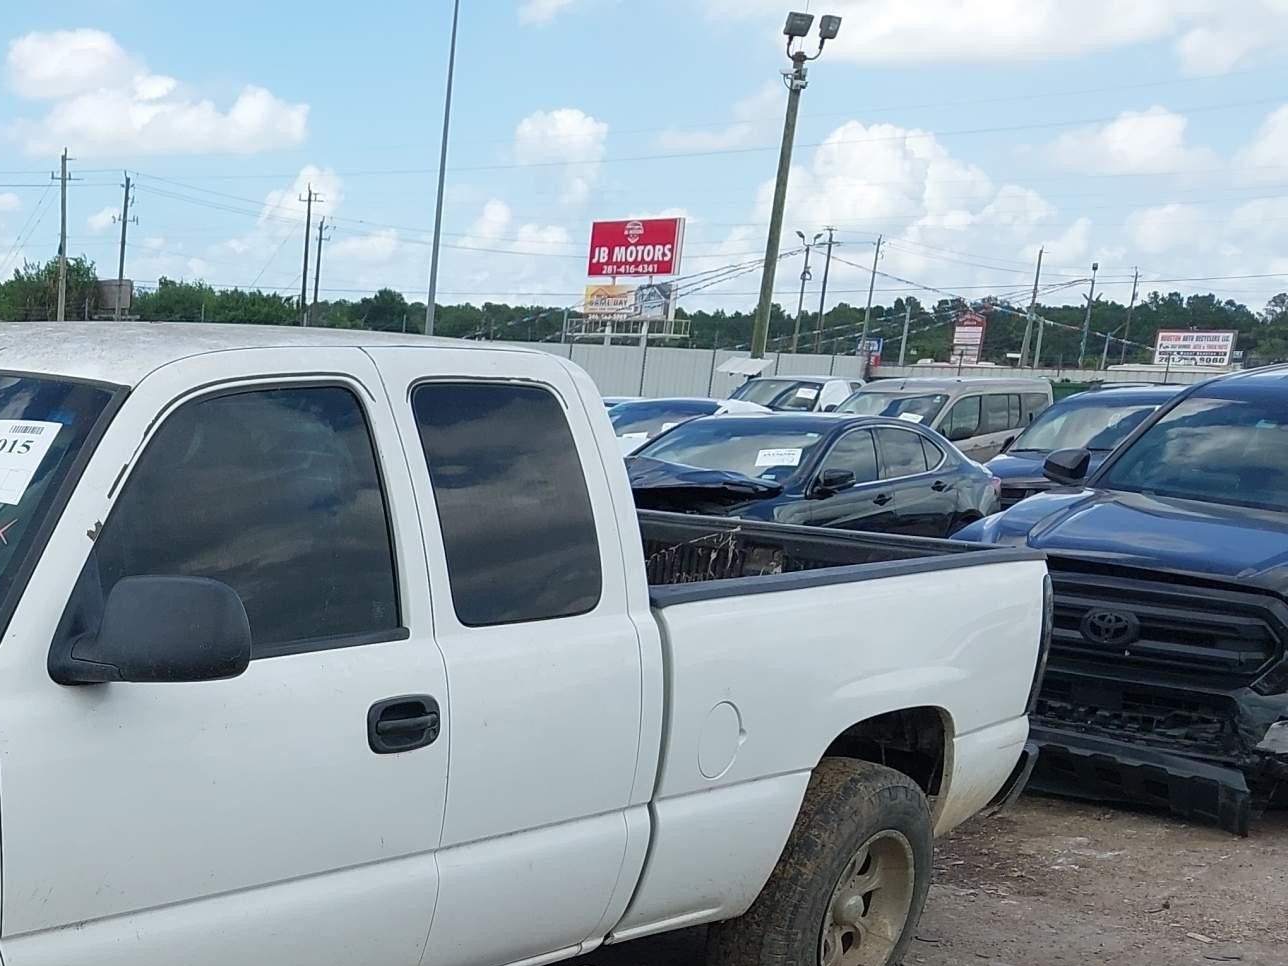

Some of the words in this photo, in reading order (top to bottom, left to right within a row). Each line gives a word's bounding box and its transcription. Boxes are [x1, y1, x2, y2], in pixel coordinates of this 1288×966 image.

[592, 247, 609, 263] JB
[612, 244, 672, 263] MOTORS
[602, 264, 658, 273] 281-416-4341
